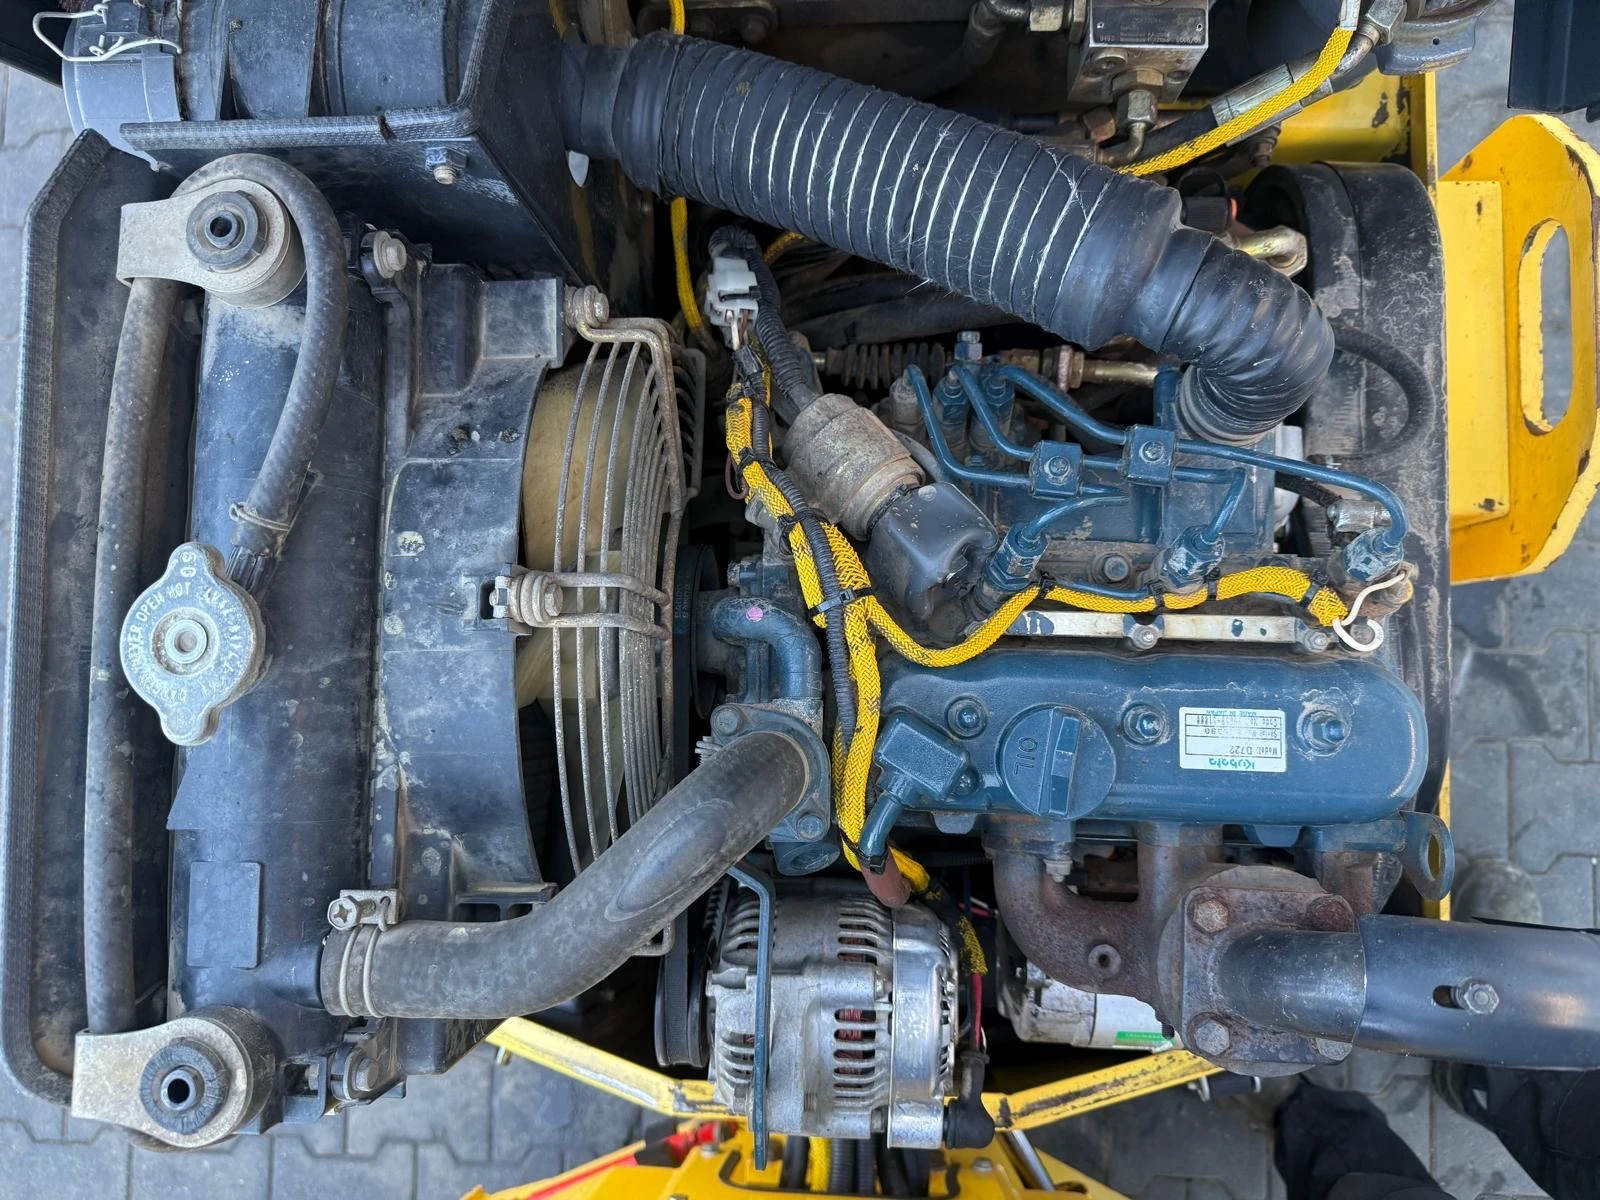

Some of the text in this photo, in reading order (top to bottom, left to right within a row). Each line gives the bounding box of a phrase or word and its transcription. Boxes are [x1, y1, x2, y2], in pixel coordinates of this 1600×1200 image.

[166, 581, 192, 600] HOT
[136, 592, 166, 622] OPEN
[127, 624, 149, 672] NEVER
[1013, 736, 1039, 776] OIL
[1229, 745, 1278, 756] Model: D722
[1209, 758, 1255, 769] Kubota
